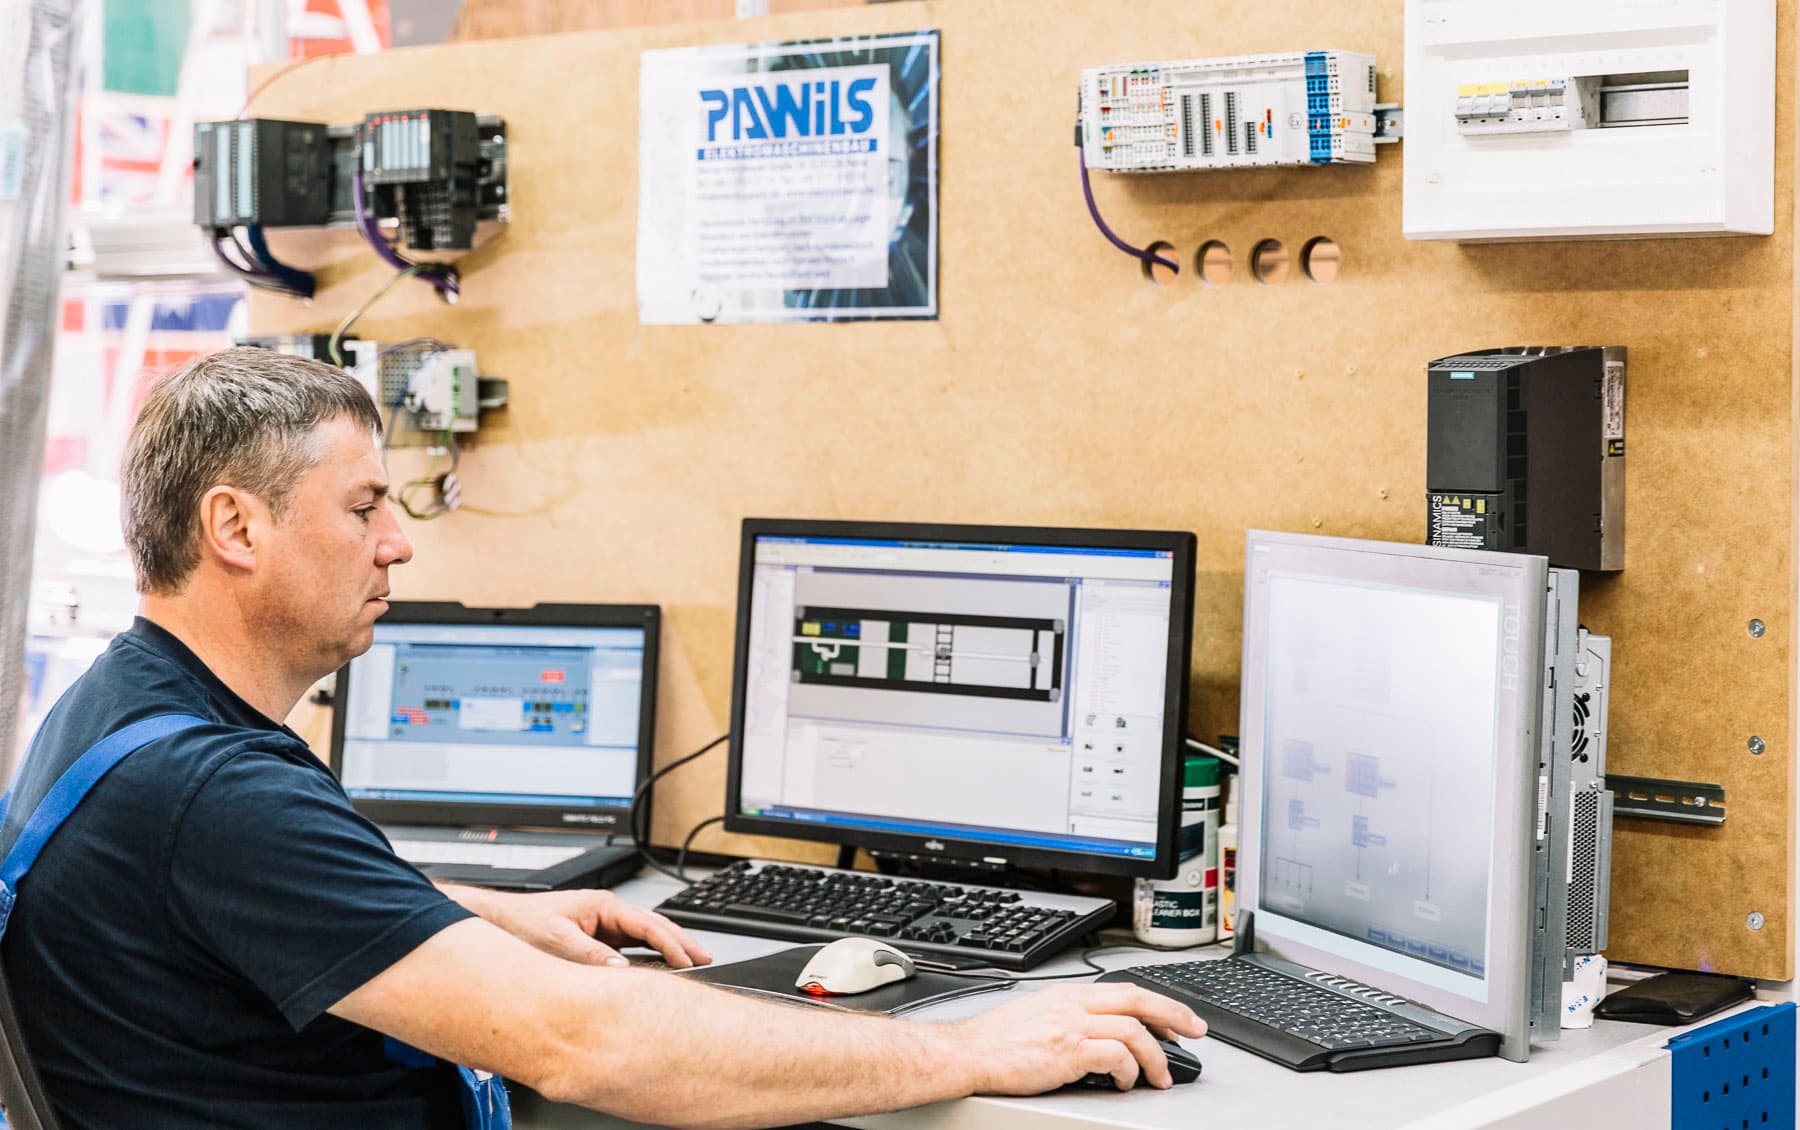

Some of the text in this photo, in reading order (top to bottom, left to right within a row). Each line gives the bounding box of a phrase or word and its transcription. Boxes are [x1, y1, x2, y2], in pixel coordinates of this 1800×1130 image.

[1432, 495, 1442, 547] SINAMICS
[1502, 600, 1520, 690] TOUCH
[1183, 909, 1201, 918] BOX
